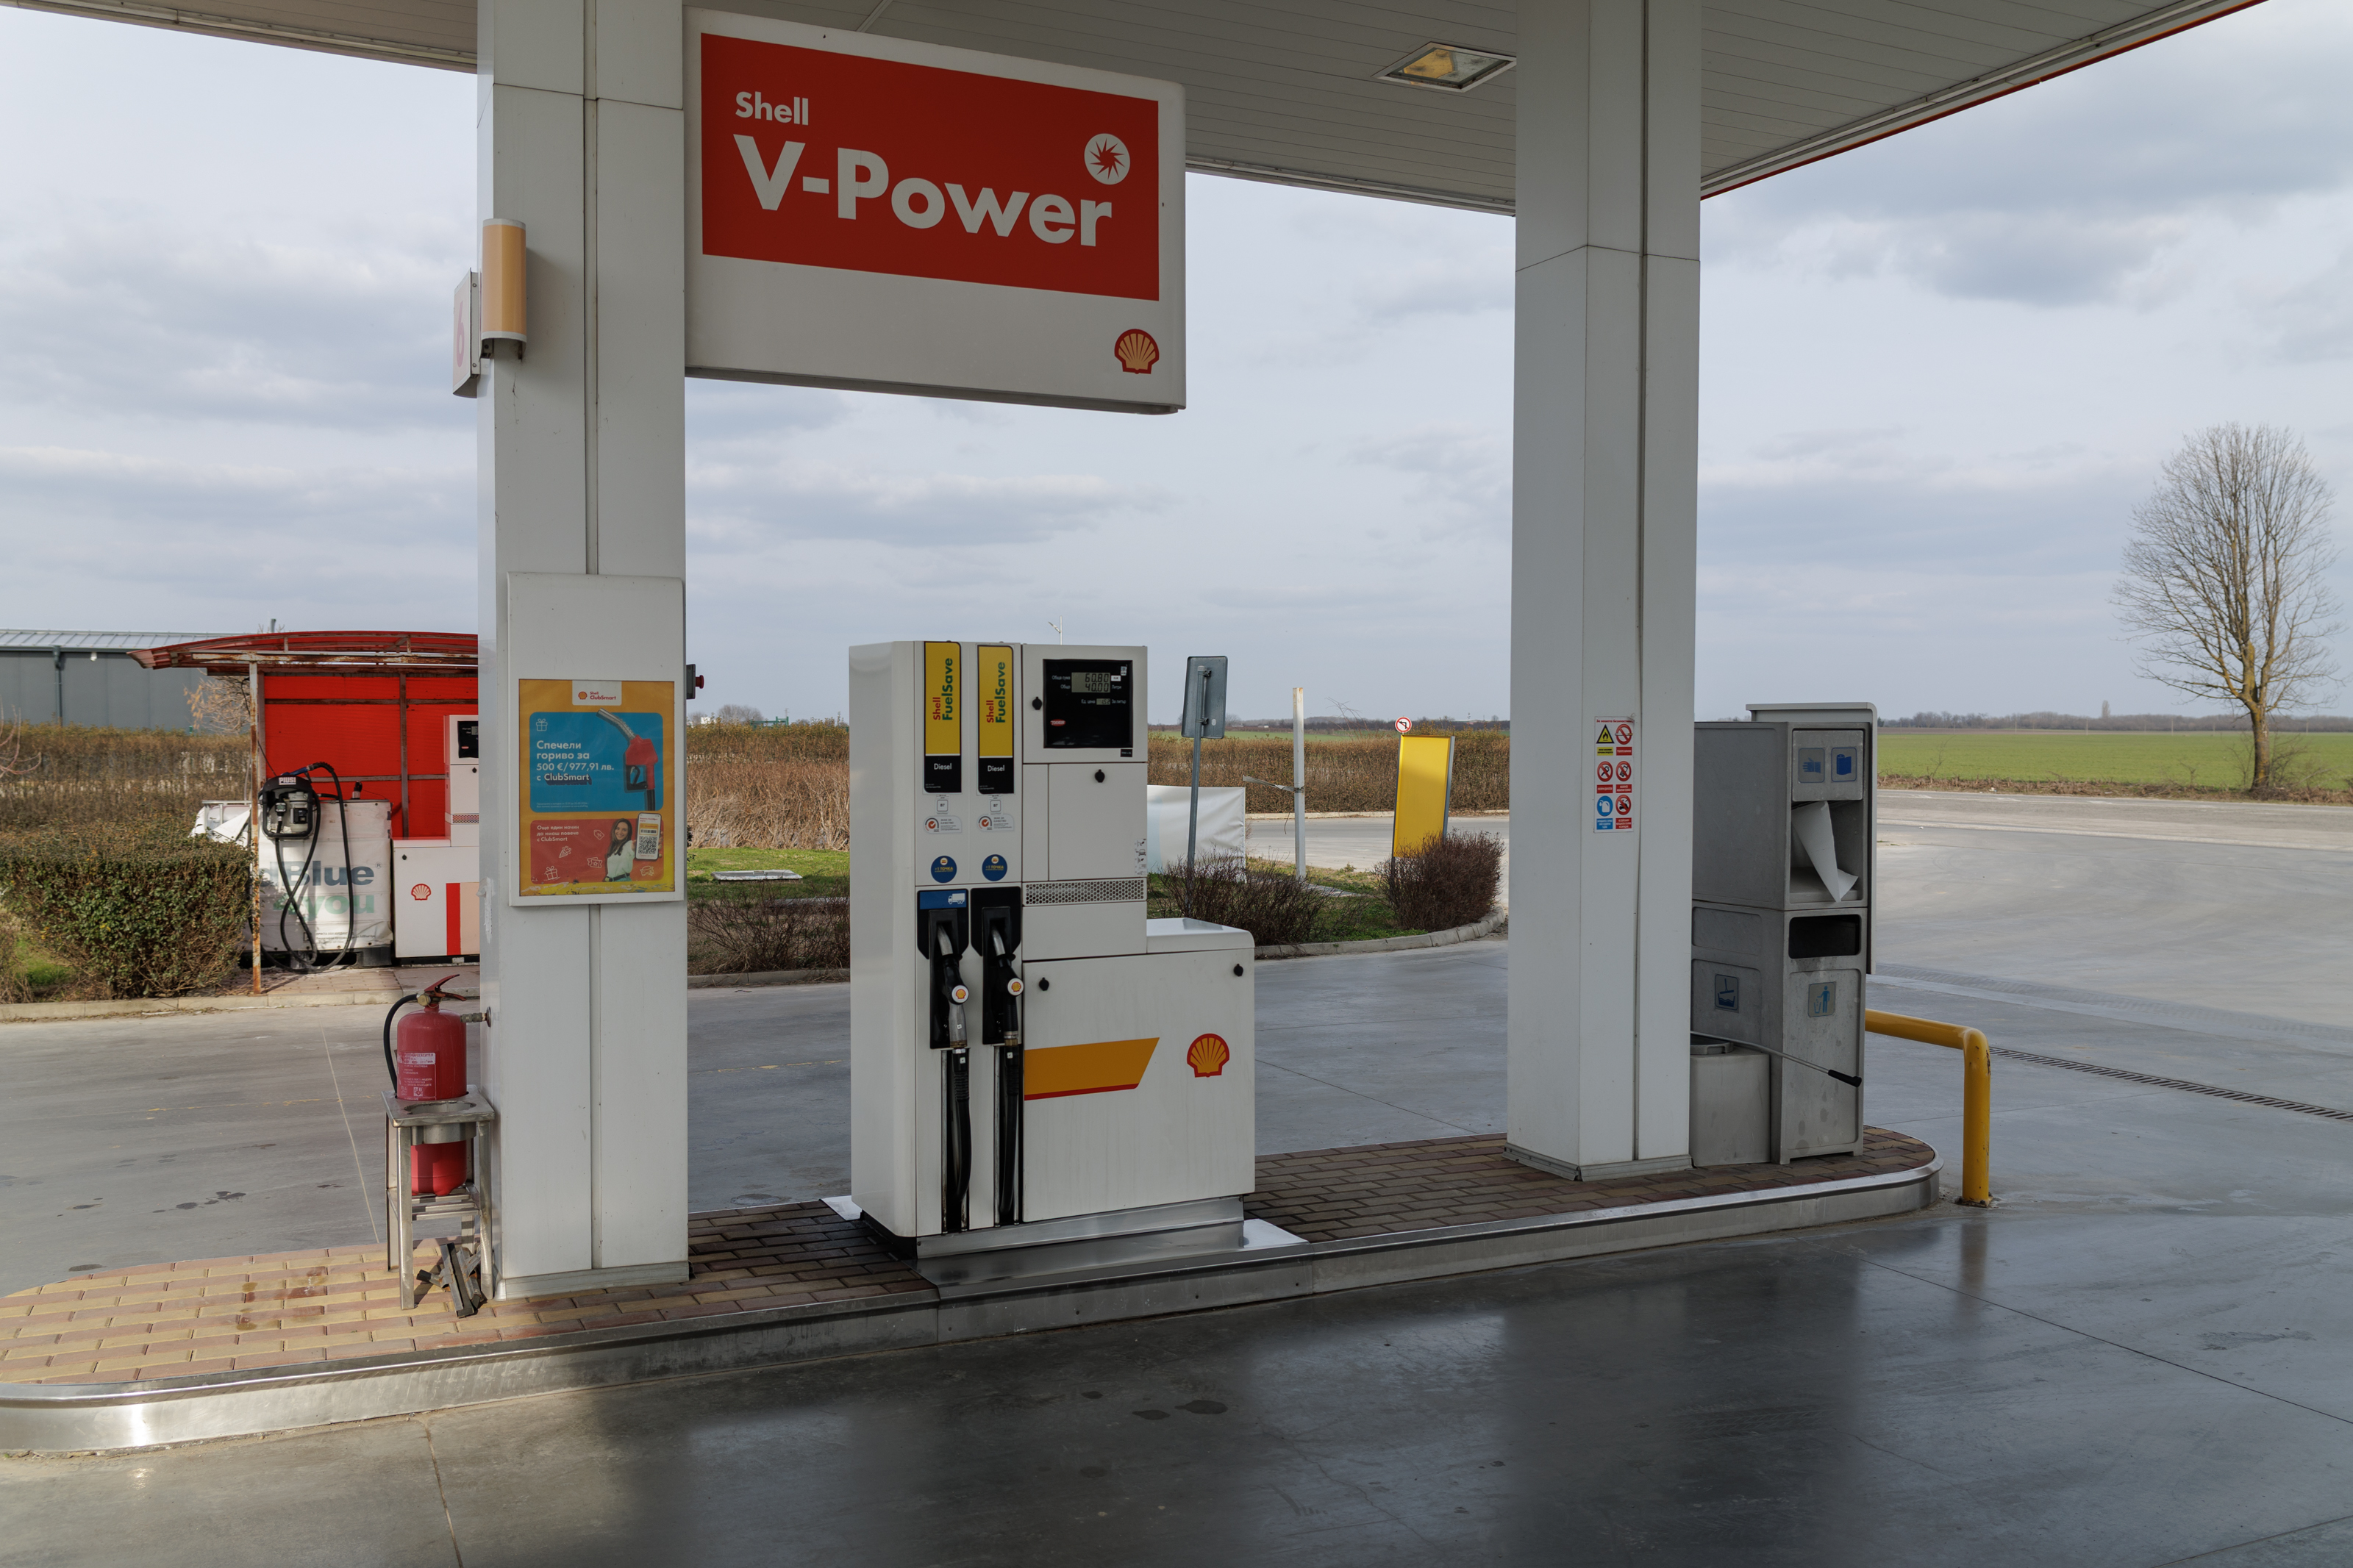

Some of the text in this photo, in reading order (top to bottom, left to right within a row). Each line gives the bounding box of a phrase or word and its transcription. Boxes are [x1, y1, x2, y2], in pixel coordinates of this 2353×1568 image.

[735, 91, 809, 125] Shell
[733, 134, 1112, 247] V-Power
[456, 300, 465, 368] 6
[942, 658, 953, 720] FuelSave
[995, 662, 1005, 723] FuelSave
[932, 697, 940, 720] Shell
[986, 700, 994, 723] Shell
[536, 740, 581, 749] Спечели
[536, 753, 574, 762] гориво
[934, 762, 952, 770] Diesel
[544, 773, 590, 781] ClubSmart
